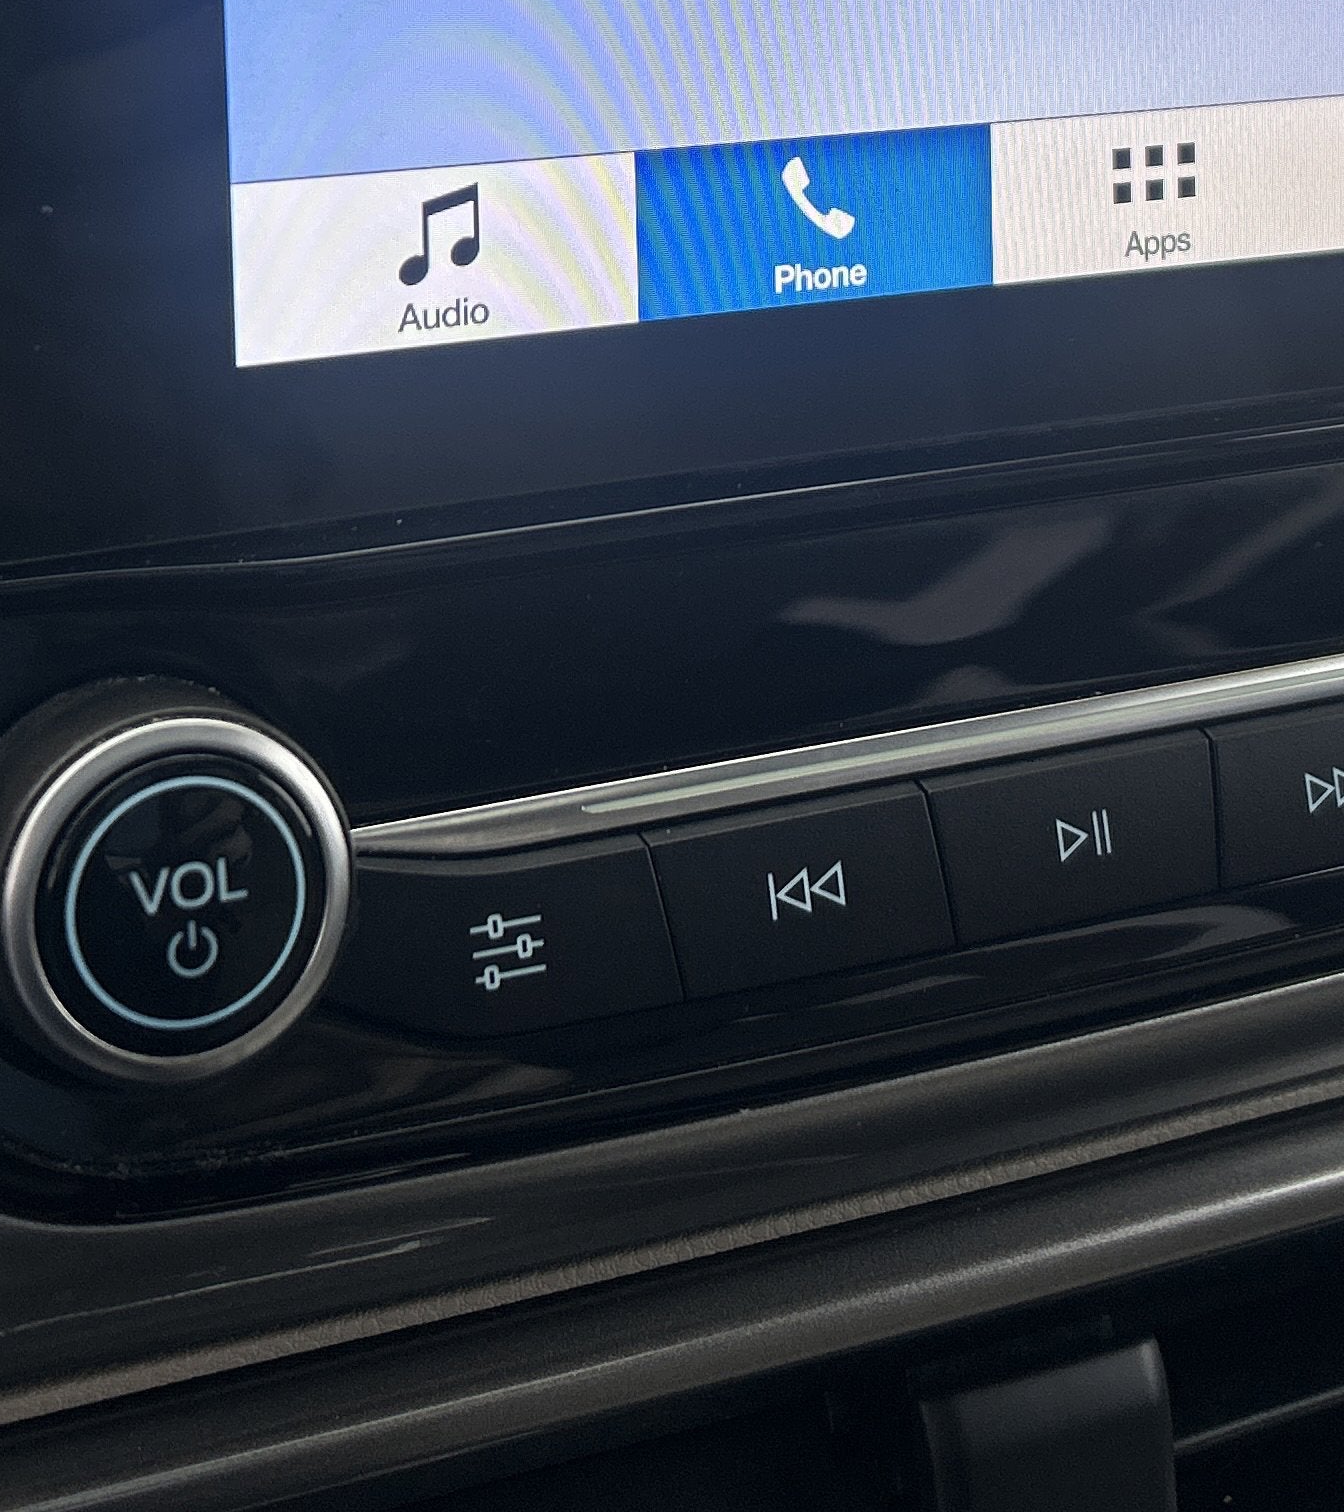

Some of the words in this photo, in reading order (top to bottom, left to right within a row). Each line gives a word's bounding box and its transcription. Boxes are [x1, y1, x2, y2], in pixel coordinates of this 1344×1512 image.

[1124, 231, 1192, 261] Apps
[773, 263, 868, 294] Phone
[397, 298, 490, 332] Audio
[130, 857, 249, 917] VOL
